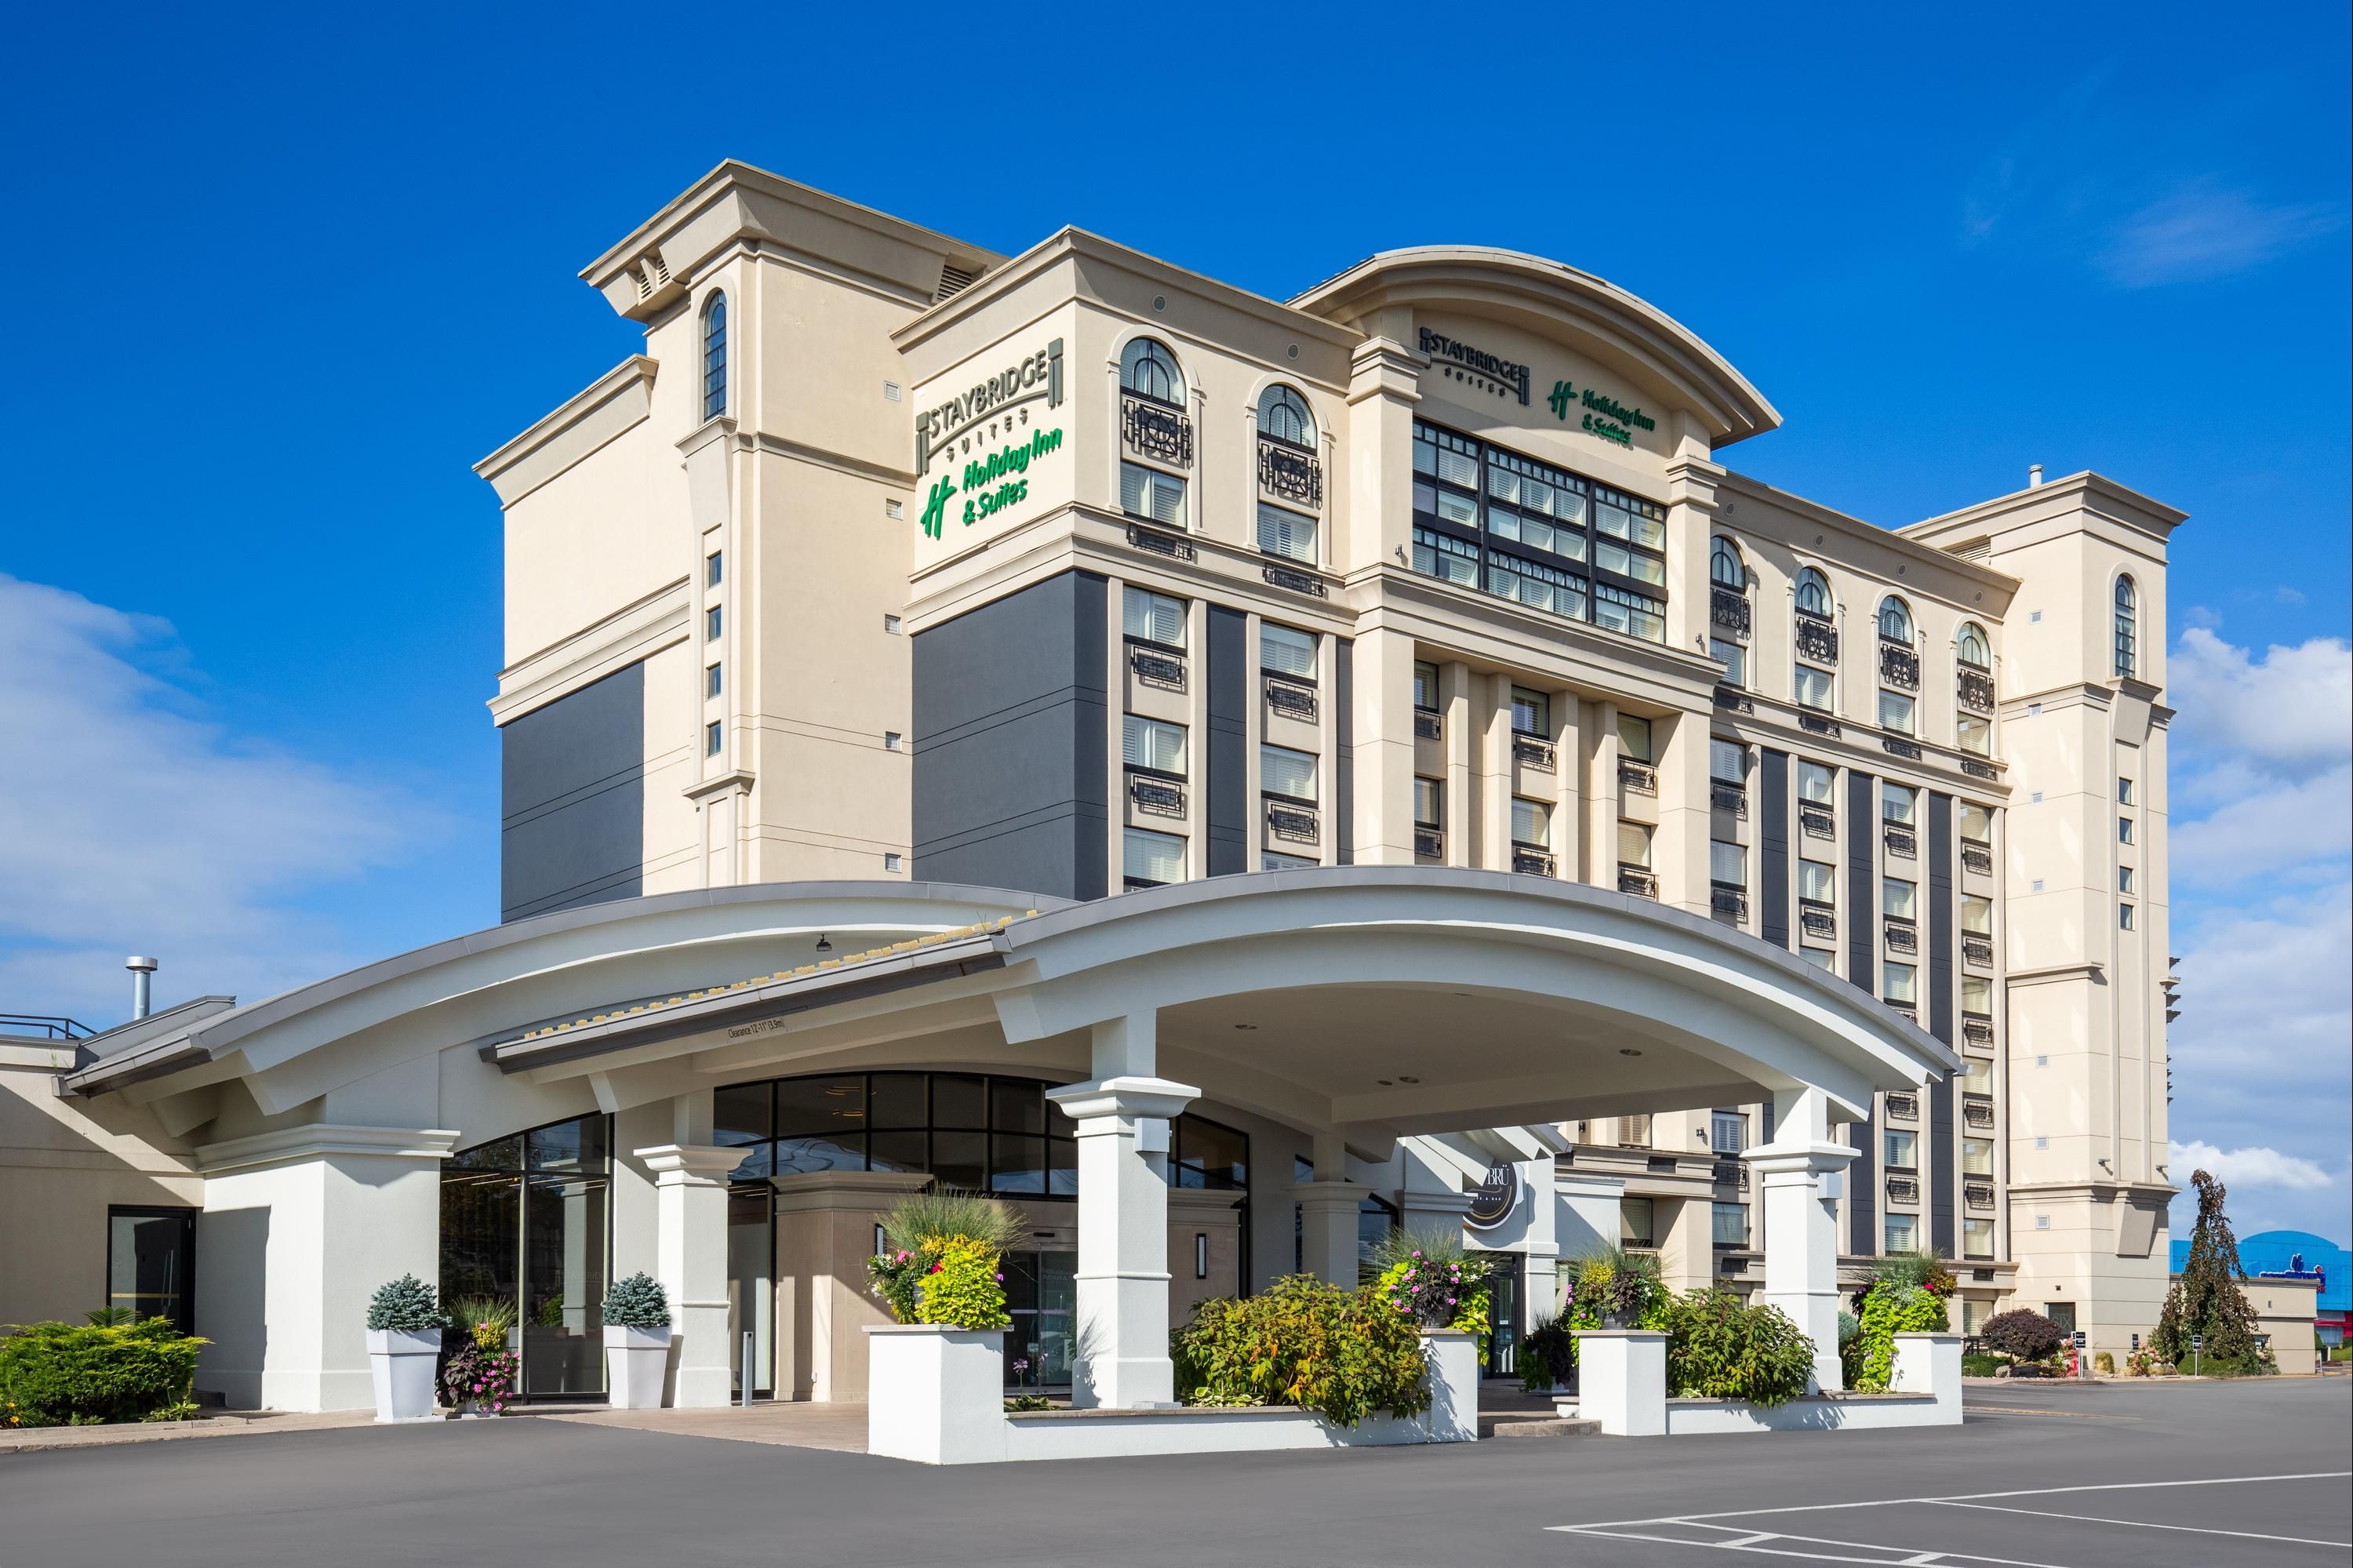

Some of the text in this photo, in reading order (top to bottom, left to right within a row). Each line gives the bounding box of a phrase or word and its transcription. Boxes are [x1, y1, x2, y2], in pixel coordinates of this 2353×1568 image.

[1431, 333, 1519, 381] STAYBRIDGE
[929, 350, 1047, 438] STAYBRIDGE
[1445, 367, 1506, 397] SUITES
[1582, 389, 1655, 431] Holiday Inn
[1593, 417, 1632, 444] Suites
[946, 407, 1028, 462] SUITES
[962, 428, 1063, 494] Holiday Inn
[962, 479, 1028, 526] & Suites
[728, 1028, 751, 1038] Clearance
